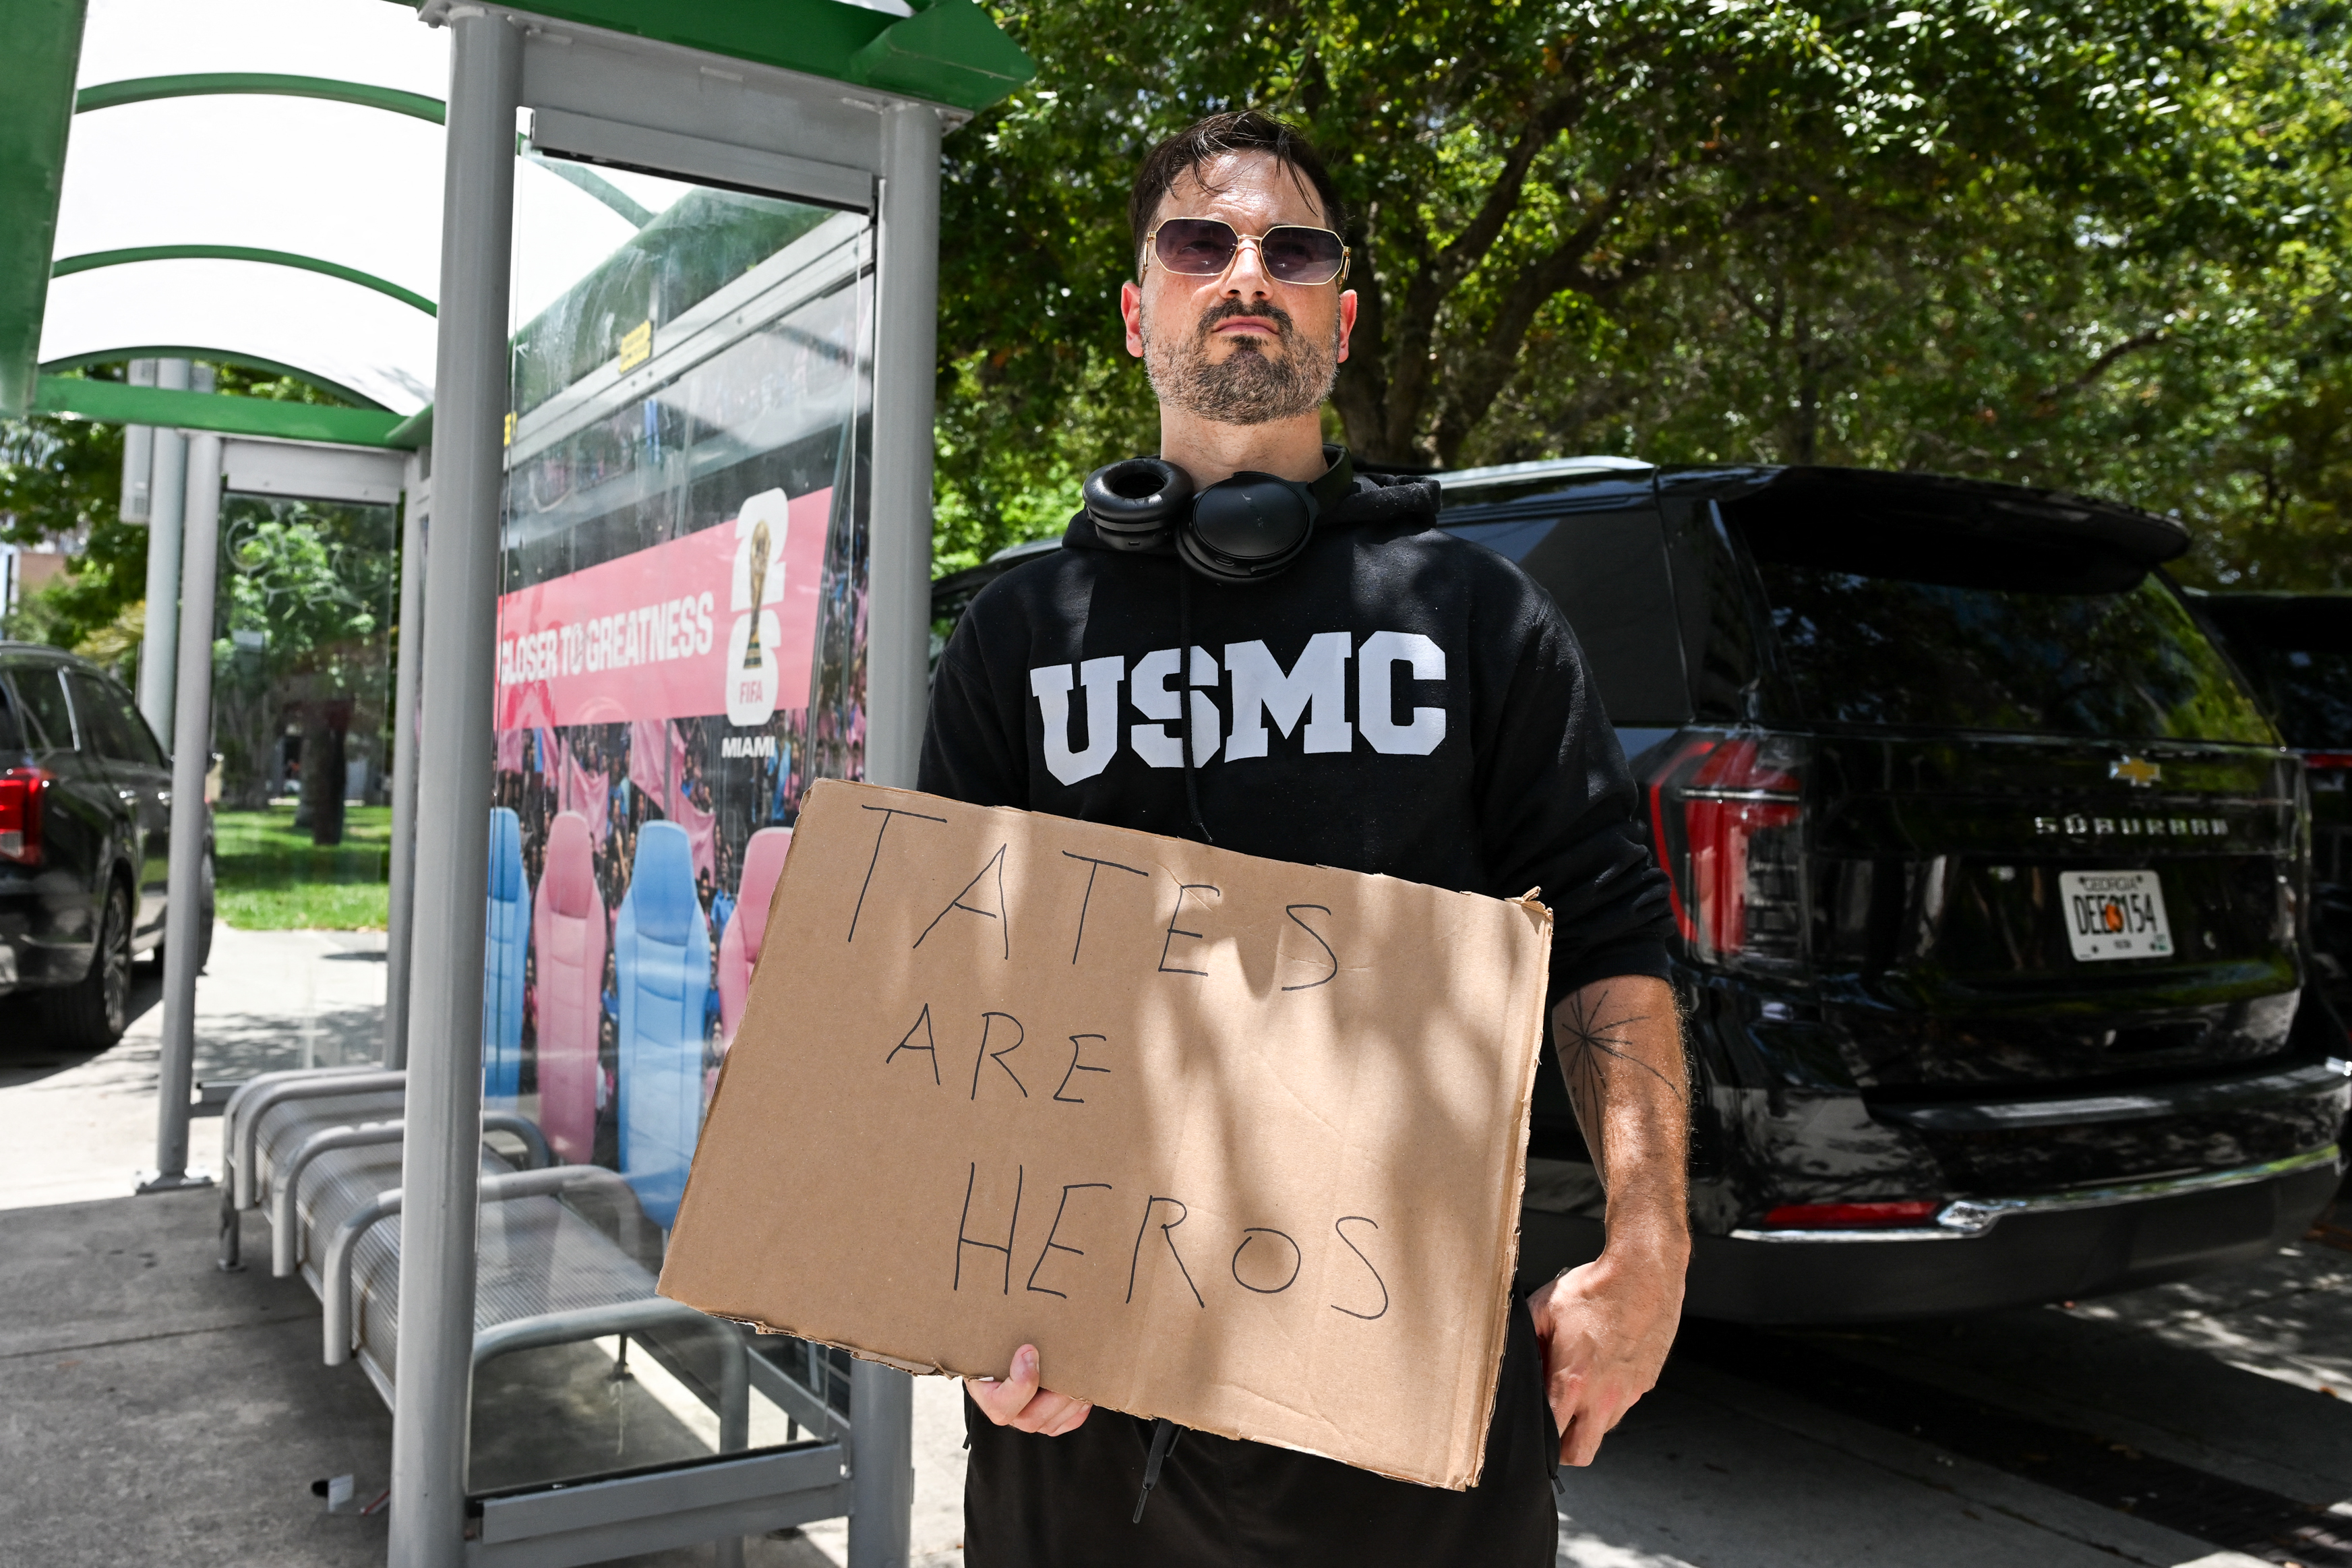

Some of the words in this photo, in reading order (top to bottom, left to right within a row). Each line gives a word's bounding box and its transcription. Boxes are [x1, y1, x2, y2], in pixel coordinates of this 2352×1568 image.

[560, 622, 585, 677] TO
[586, 591, 715, 673] GREATNESS
[740, 680, 763, 704] FIFA
[1030, 630, 1446, 786] USMC
[721, 735, 776, 758] MIAMI
[847, 804, 1338, 992] TATES
[886, 1002, 1111, 1104] ARE
[953, 1162, 1389, 1319] HEROS
